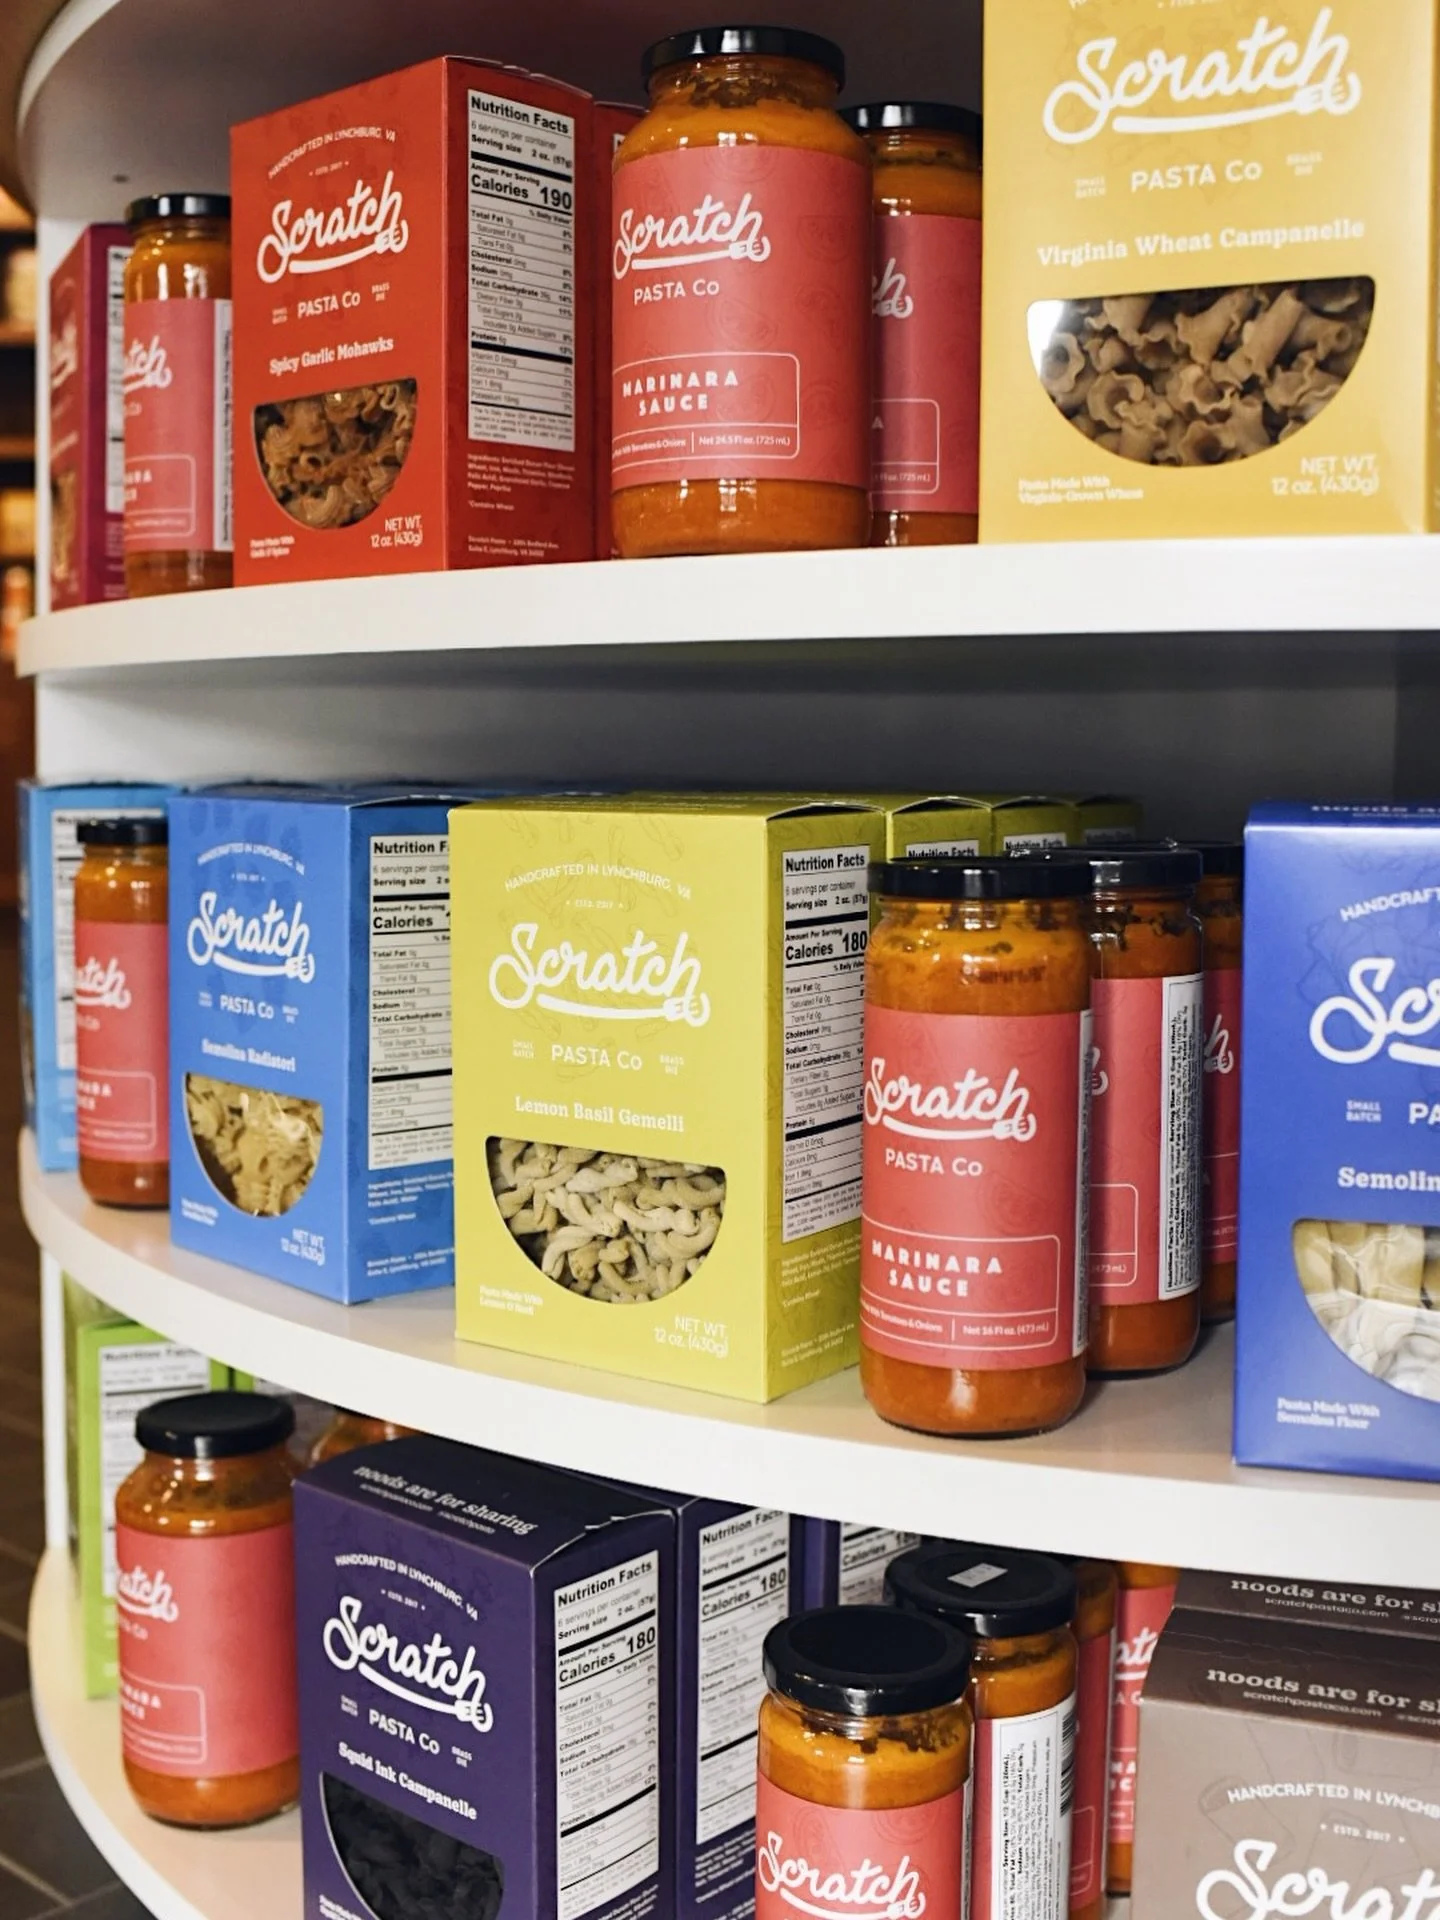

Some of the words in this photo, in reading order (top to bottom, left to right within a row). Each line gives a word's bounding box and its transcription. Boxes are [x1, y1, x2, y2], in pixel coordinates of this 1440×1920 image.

[1043, 6, 1361, 144] Scratch
[471, 96, 530, 123] Nutrition
[534, 113, 568, 134] Facts
[385, 128, 396, 143] VA
[471, 134, 503, 150] Serving
[472, 174, 528, 199] Calories
[540, 187, 572, 209] 190
[1131, 163, 1215, 193] PASTA
[1226, 160, 1263, 182] Co
[256, 170, 409, 283] Scratch
[613, 193, 771, 280] Scratch
[1037, 240, 1128, 267] Virginia
[1135, 227, 1213, 256] Wheat
[1220, 218, 1365, 249] Campanelle
[298, 294, 339, 319] PASTA
[342, 291, 360, 308] Co
[634, 282, 685, 306] PASTA
[693, 279, 720, 296] Co
[270, 356, 299, 376] Spicy
[301, 348, 334, 367] Garlic
[337, 337, 393, 360] Mohawks
[622, 369, 739, 398] MARINARA
[639, 393, 708, 416] SAUCE
[1300, 457, 1336, 476] NET
[1272, 478, 1288, 496] 12
[1320, 473, 1380, 496] (430g)
[384, 517, 403, 531] NET
[371, 535, 380, 548] 12
[373, 841, 435, 854] Nutrition
[785, 855, 834, 872] Nutrition
[837, 854, 865, 868] Facts
[373, 878, 406, 887] Serving
[505, 863, 584, 892] HANDCRAFTED
[588, 863, 599, 874] IN
[678, 883, 691, 901] VA
[786, 900, 812, 910] Serving
[187, 891, 315, 984] Scratch
[373, 916, 433, 929] Calories
[785, 943, 833, 960] Calories
[842, 931, 868, 953] 180
[489, 923, 711, 1028] Scratch
[220, 994, 257, 1017] PASTA
[258, 1002, 274, 1019] Co
[551, 1044, 611, 1068] PASTA
[617, 1050, 643, 1071] Co
[515, 1095, 569, 1118] Lemon
[574, 1103, 615, 1124] Basil
[618, 1109, 685, 1132] Gemelli
[864, 1057, 1036, 1142] Scratch
[885, 1148, 944, 1175] PASTA
[952, 1157, 983, 1177] Co
[872, 1239, 1003, 1274] MARINARA
[889, 1268, 969, 1297] SAUCE
[674, 1315, 700, 1333] NET
[654, 1327, 667, 1343] 12
[688, 1337, 729, 1359] (430g)
[353, 1466, 408, 1489] noods
[405, 1483, 437, 1500] are
[435, 1493, 466, 1509] for
[462, 1503, 538, 1536] sharing
[702, 1520, 753, 1546] Nutrition
[756, 1509, 784, 1525] Facts
[843, 1544, 886, 1566] Calories
[397, 1563, 409, 1576] IN
[466, 1602, 479, 1621] VA
[558, 1578, 615, 1607] Nutrition
[619, 1561, 652, 1582] Facts
[702, 1589, 750, 1617] Calories
[760, 1568, 787, 1592] 180
[1231, 1579, 1315, 1600] noods
[1322, 1589, 1366, 1605] are
[1374, 1593, 1414, 1611] for
[558, 1623, 590, 1640] Serving
[323, 1595, 493, 1733] Scratch
[560, 1653, 615, 1682] Calories
[627, 1626, 656, 1653] 180
[1207, 1669, 1300, 1693] noods
[1307, 1683, 1358, 1701] are
[1367, 1689, 1411, 1710] for
[368, 1709, 415, 1745] PASTA
[418, 1732, 440, 1755] Co
[339, 1742, 373, 1771] Squid
[375, 1760, 397, 1784] Ink
[399, 1772, 477, 1820] Campanelle
[1227, 1783, 1349, 1805] HANDCRAFTED
[1353, 1784, 1372, 1802] IN
[758, 1830, 926, 1920] Scratch
